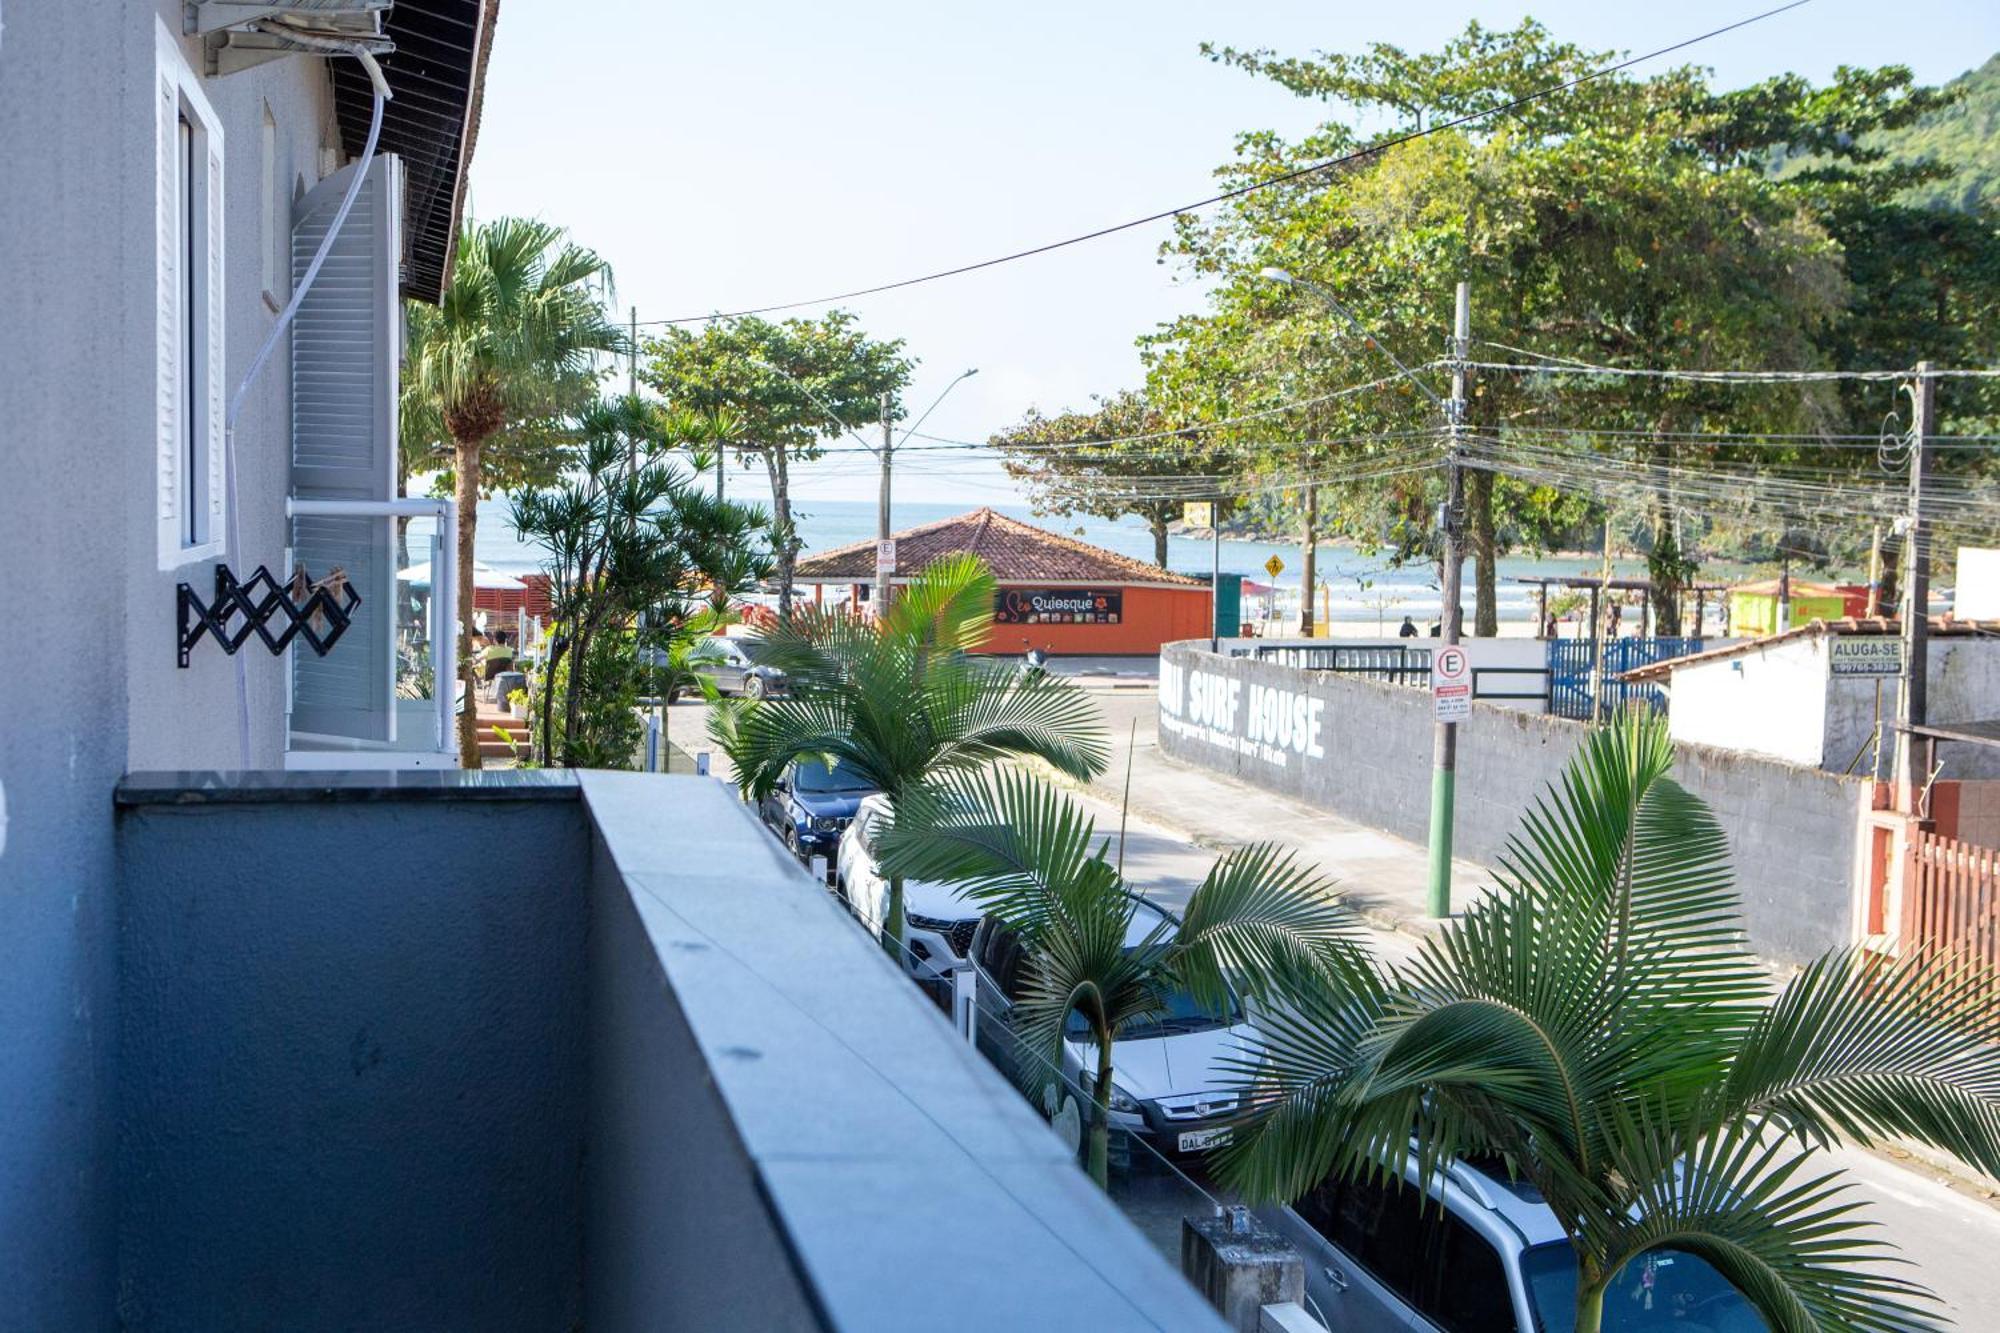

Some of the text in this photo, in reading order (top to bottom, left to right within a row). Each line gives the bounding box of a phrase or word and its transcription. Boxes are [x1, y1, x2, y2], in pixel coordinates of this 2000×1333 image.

[1032, 596, 1093, 612] Quiesque
[1835, 643, 1899, 656] ALUGA-SE
[1446, 655, 1458, 672] E
[1189, 669, 1241, 733] SURF
[1247, 684, 1325, 759] HOUSE
